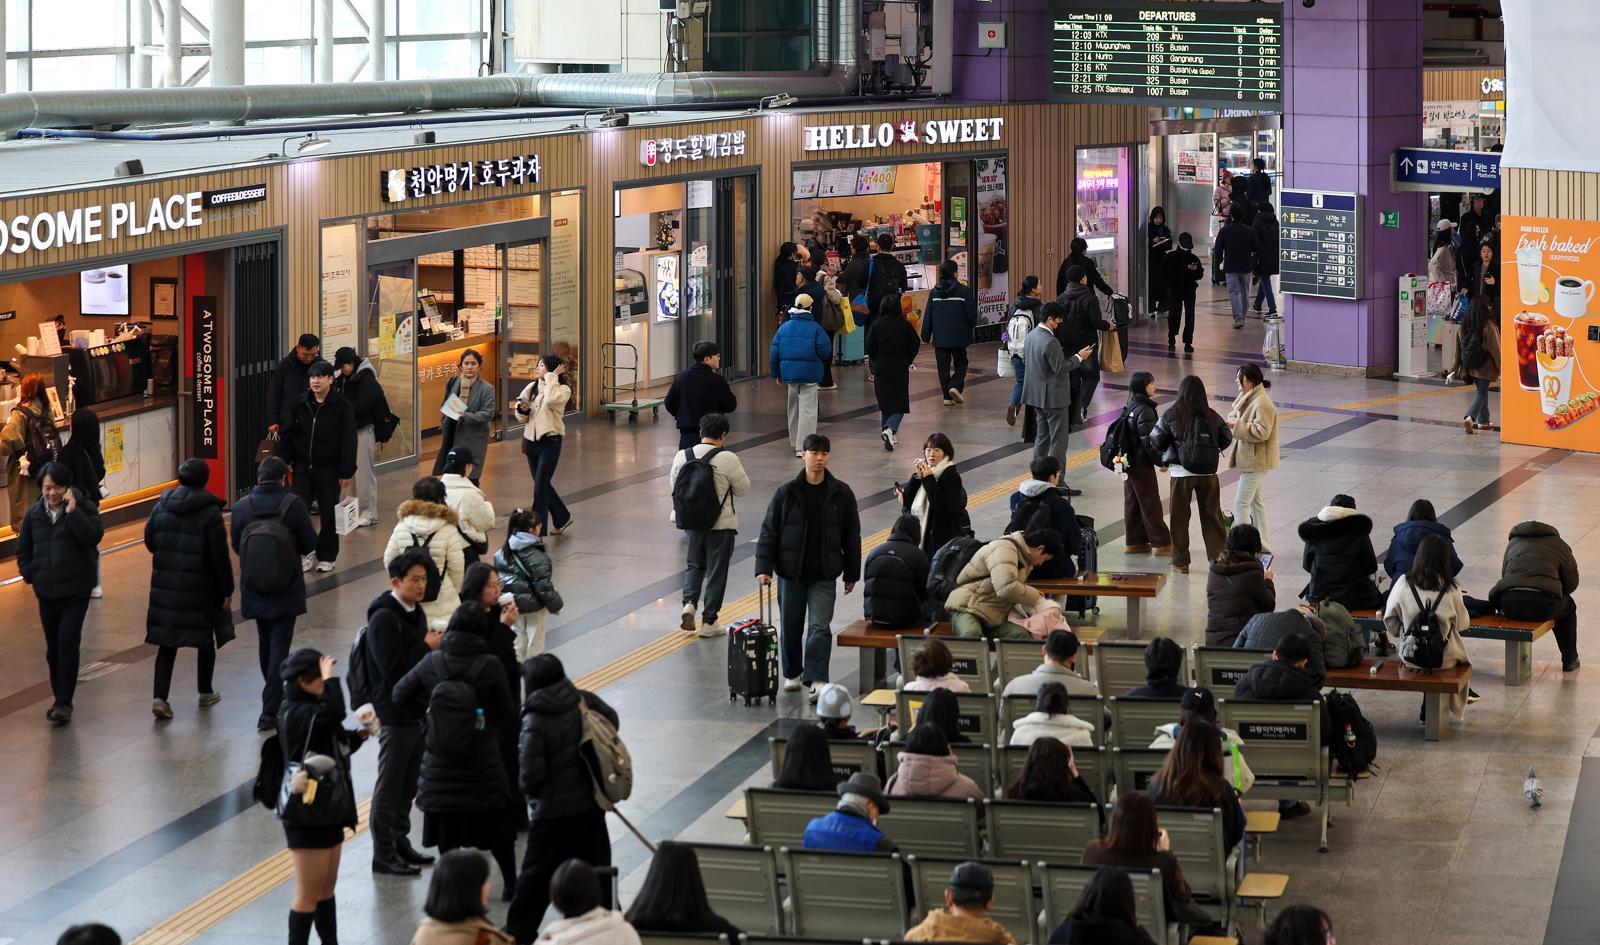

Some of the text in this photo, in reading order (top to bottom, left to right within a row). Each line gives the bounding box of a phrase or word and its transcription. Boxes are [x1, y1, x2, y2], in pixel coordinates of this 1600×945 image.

[1139, 11, 1196, 21] DEPARTURES
[1072, 31, 1092, 39] 12:03
[1146, 33, 1160, 41] 209
[1170, 33, 1183, 41] Jinju
[1238, 35, 1243, 44] 8
[1259, 36, 1264, 44] 0
[1265, 36, 1276, 44] min
[1072, 42, 1092, 50] 12:10
[1095, 43, 1131, 51] Mugunghwa
[1147, 44, 1164, 52] 1155
[1238, 46, 1243, 55] 6
[1259, 46, 1264, 55] 0
[1265, 46, 1276, 55] min
[1072, 52, 1092, 61] 12:14
[1147, 55, 1164, 63] 1853
[1170, 56, 1204, 64] Gangneung
[1238, 57, 1242, 66] 1
[1259, 58, 1264, 66] 0
[1265, 58, 1276, 66] min
[1072, 63, 1092, 72] 12:16
[1147, 66, 1160, 74] 163
[1238, 68, 1243, 77] 6
[1259, 69, 1264, 77] 0
[1265, 69, 1276, 77] min
[1072, 74, 1092, 82] 12:21
[1146, 77, 1160, 85] 325
[1170, 77, 1188, 85] Busan
[1238, 79, 1243, 88] 7
[1259, 80, 1264, 89] 0
[1265, 80, 1276, 89] min
[1072, 85, 1092, 93] 12:25
[1105, 86, 1134, 94] Saemaeul
[1147, 87, 1164, 96] 1007
[1170, 88, 1188, 96] Busan
[1238, 91, 1243, 99] 6
[1259, 92, 1264, 100] 0
[1265, 92, 1276, 100] min
[1443, 110, 1467, 122] 받으세요
[804, 118, 1004, 150] HELLO SWEET
[661, 130, 746, 163] 청도할매김밥
[1430, 161, 1469, 171] 승차권 사는 곳
[1475, 163, 1497, 173] 타는 곳
[410, 154, 541, 198] 천안명가 호두과자
[863, 172, 892, 184] 4,400
[211, 188, 266, 204] COFFEE&DESSERT
[110, 191, 203, 239] PLACE
[1325, 214, 1339, 223] 나가는
[1514, 233, 1592, 254] fresh baked
[1549, 254, 1580, 262] HAPPINESS
[979, 291, 1006, 306] Hawaii
[979, 303, 1004, 314] COFFEE
[203, 310, 213, 446] A TWOSOME PLACE
[1221, 671, 1247, 679] 교통약자
